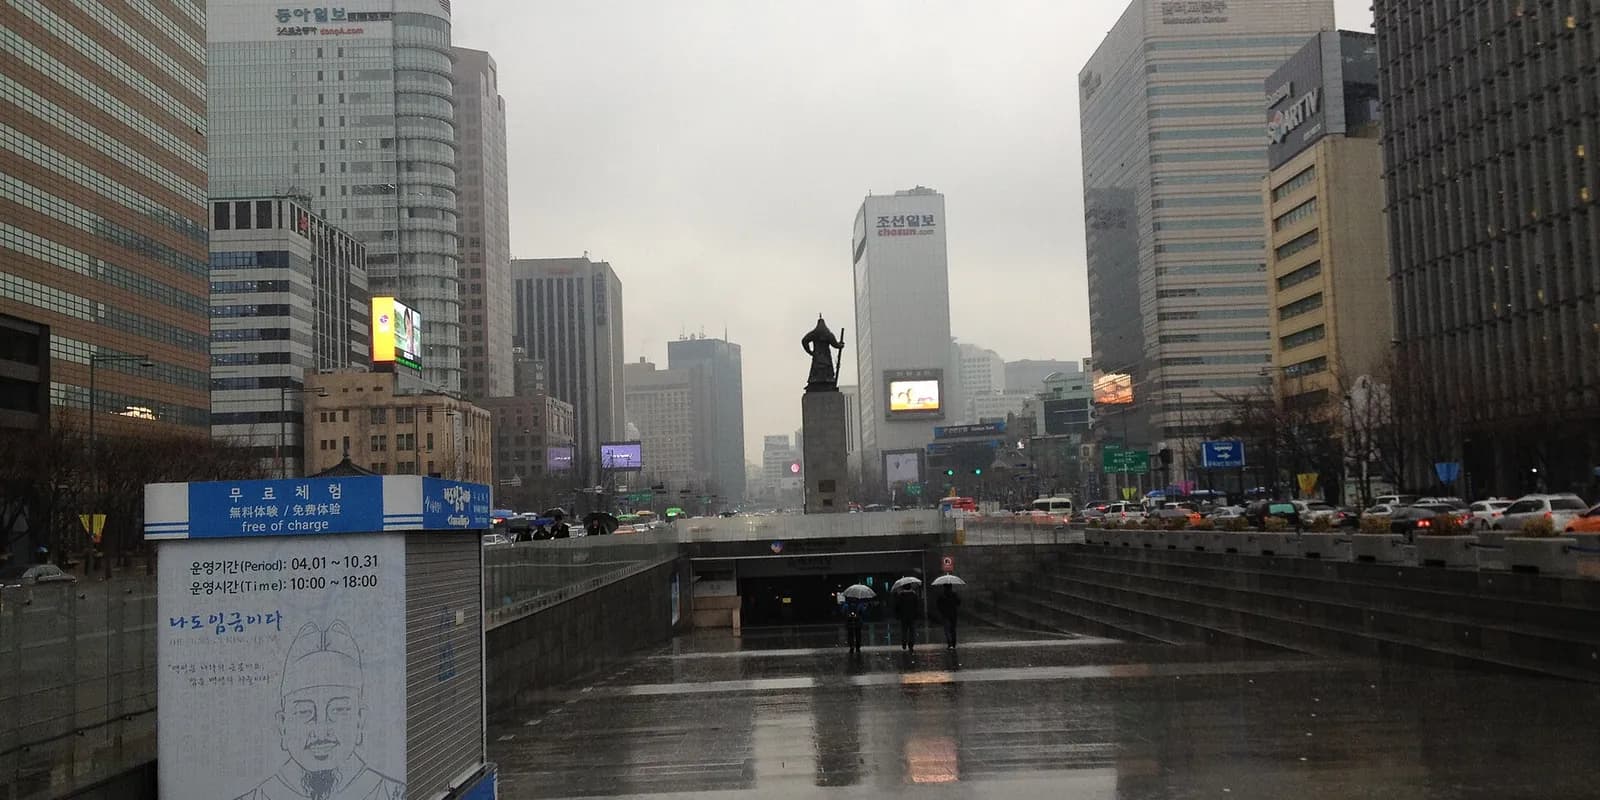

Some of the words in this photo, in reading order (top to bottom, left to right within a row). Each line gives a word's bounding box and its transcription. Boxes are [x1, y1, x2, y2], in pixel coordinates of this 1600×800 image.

[275, 8, 347, 23] 동아일보
[876, 214, 936, 228] 조선일보
[242, 521, 266, 532] free
[270, 519, 284, 531] of
[288, 519, 329, 532] charge
[291, 556, 326, 571] 04.01
[344, 554, 378, 569] 10.31
[290, 577, 326, 590] 10:00
[343, 575, 377, 588] 18:00
